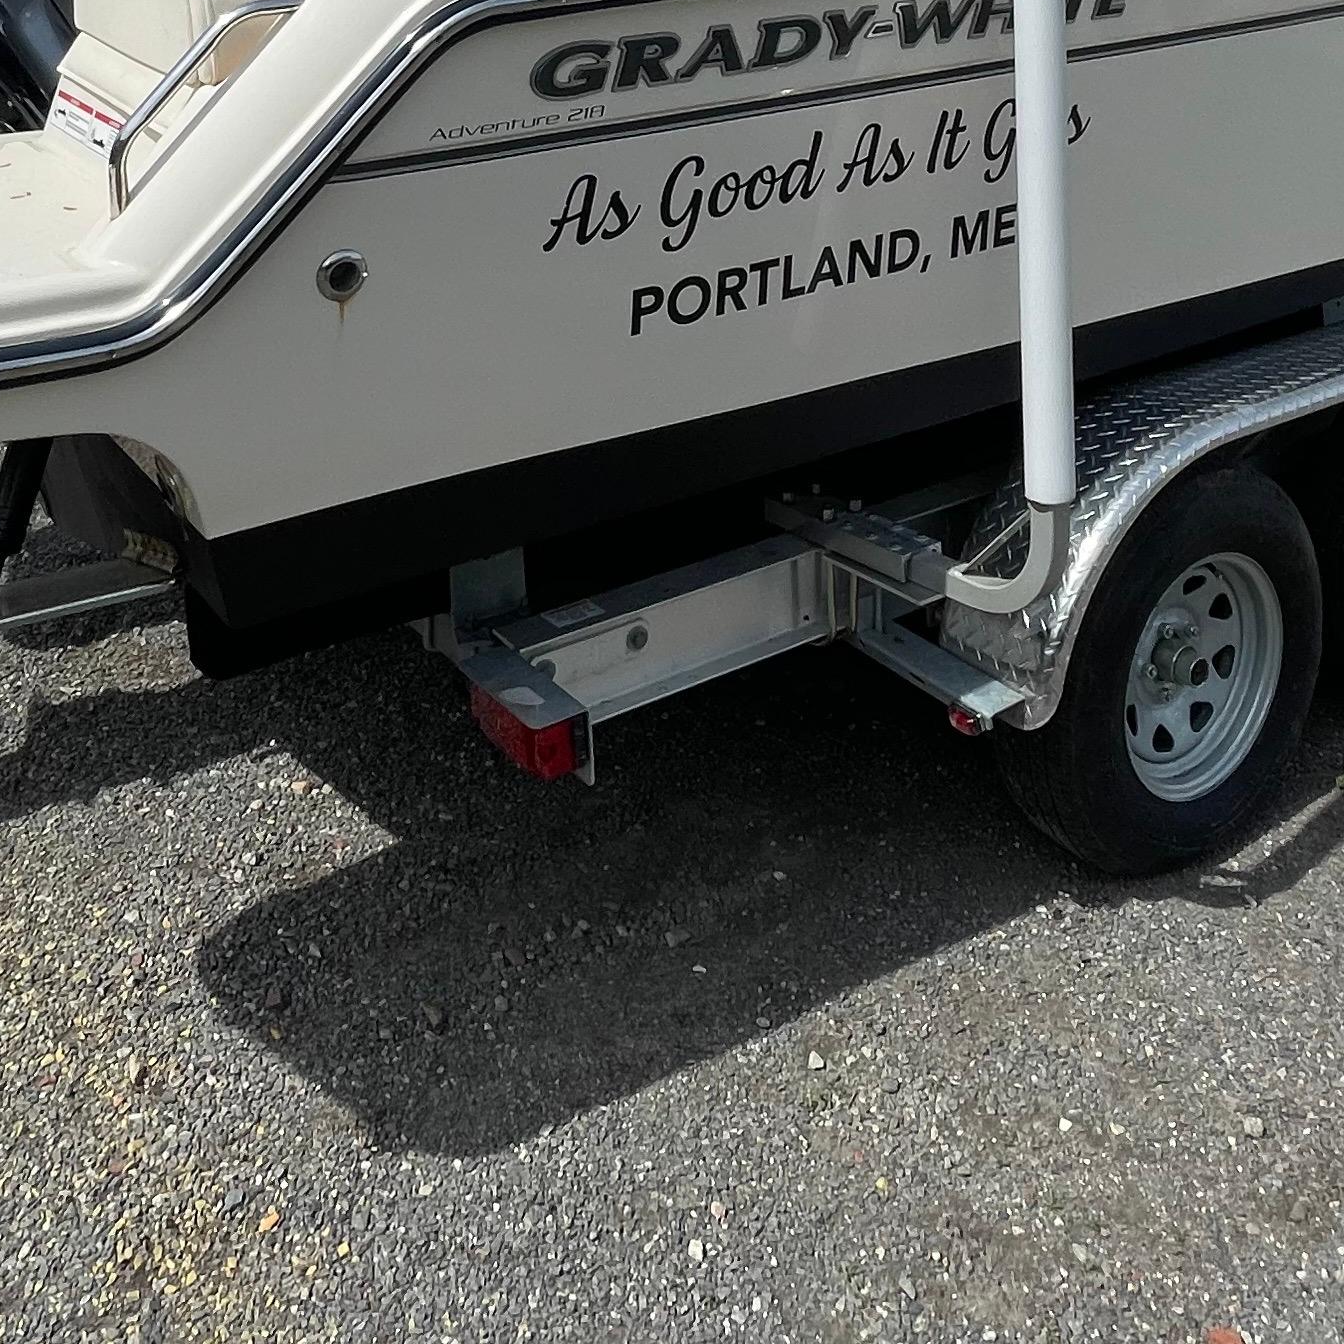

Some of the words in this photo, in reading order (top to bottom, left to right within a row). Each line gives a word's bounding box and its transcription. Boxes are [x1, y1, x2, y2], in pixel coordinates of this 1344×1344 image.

[429, 112, 561, 142] Adventure
[542, 172, 641, 253] As
[659, 132, 823, 252] Good
[836, 122, 917, 197] As
[926, 108, 970, 174] It
[983, 98, 1092, 184] Gs
[629, 226, 932, 336] PORTLAND,
[950, 203, 1018, 259] ME
